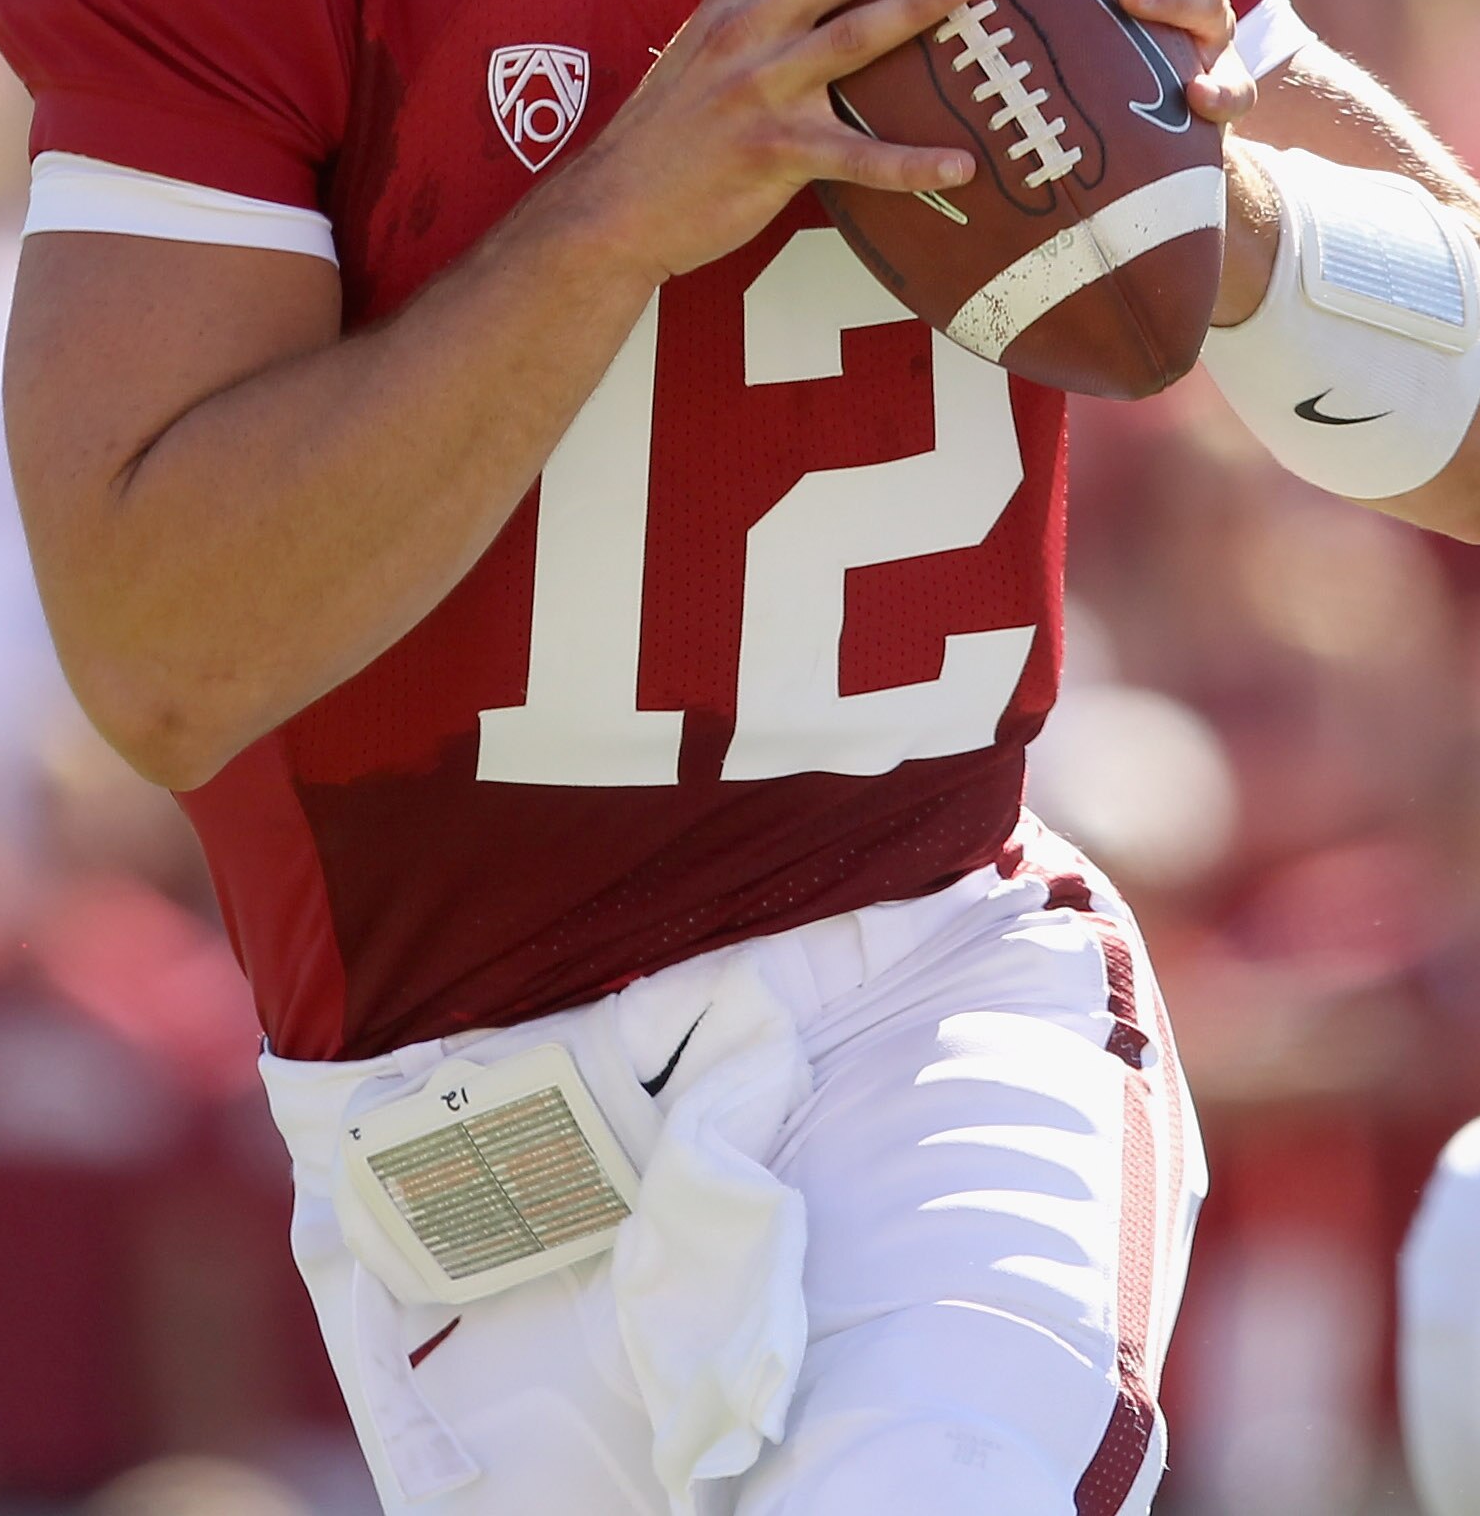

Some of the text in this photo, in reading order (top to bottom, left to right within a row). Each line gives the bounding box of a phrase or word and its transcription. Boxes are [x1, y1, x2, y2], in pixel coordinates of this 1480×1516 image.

[495, 49, 584, 122] PAC
[514, 98, 566, 143] 10
[476, 227, 1037, 787] 12
[440, 1086, 470, 1112] 12
